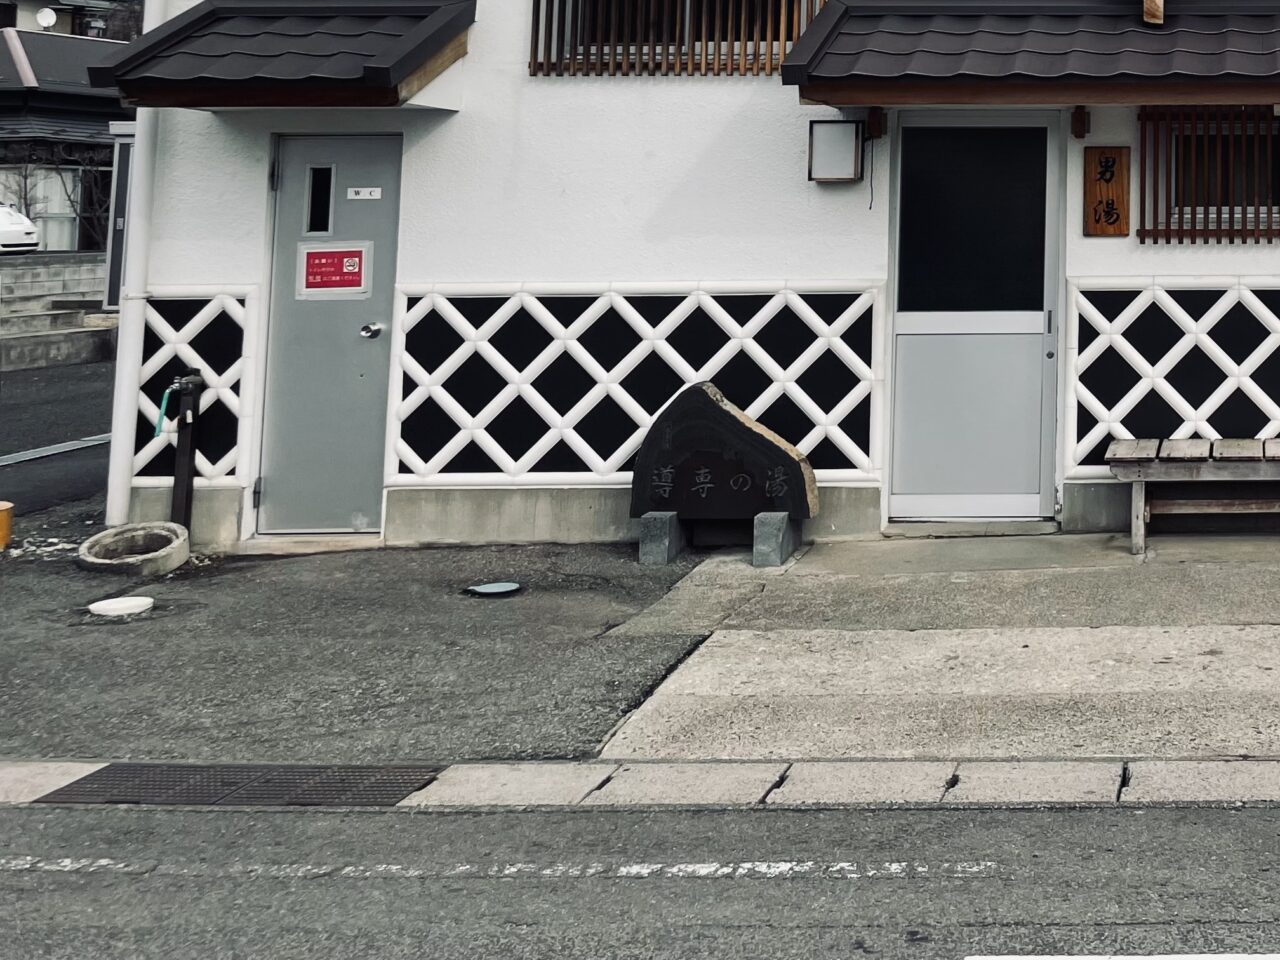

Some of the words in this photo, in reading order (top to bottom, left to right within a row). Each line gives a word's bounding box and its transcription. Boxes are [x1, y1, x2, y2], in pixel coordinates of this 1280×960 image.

[1093, 155, 1120, 225] 男湯
[651, 464, 791, 499] 導専の湯
